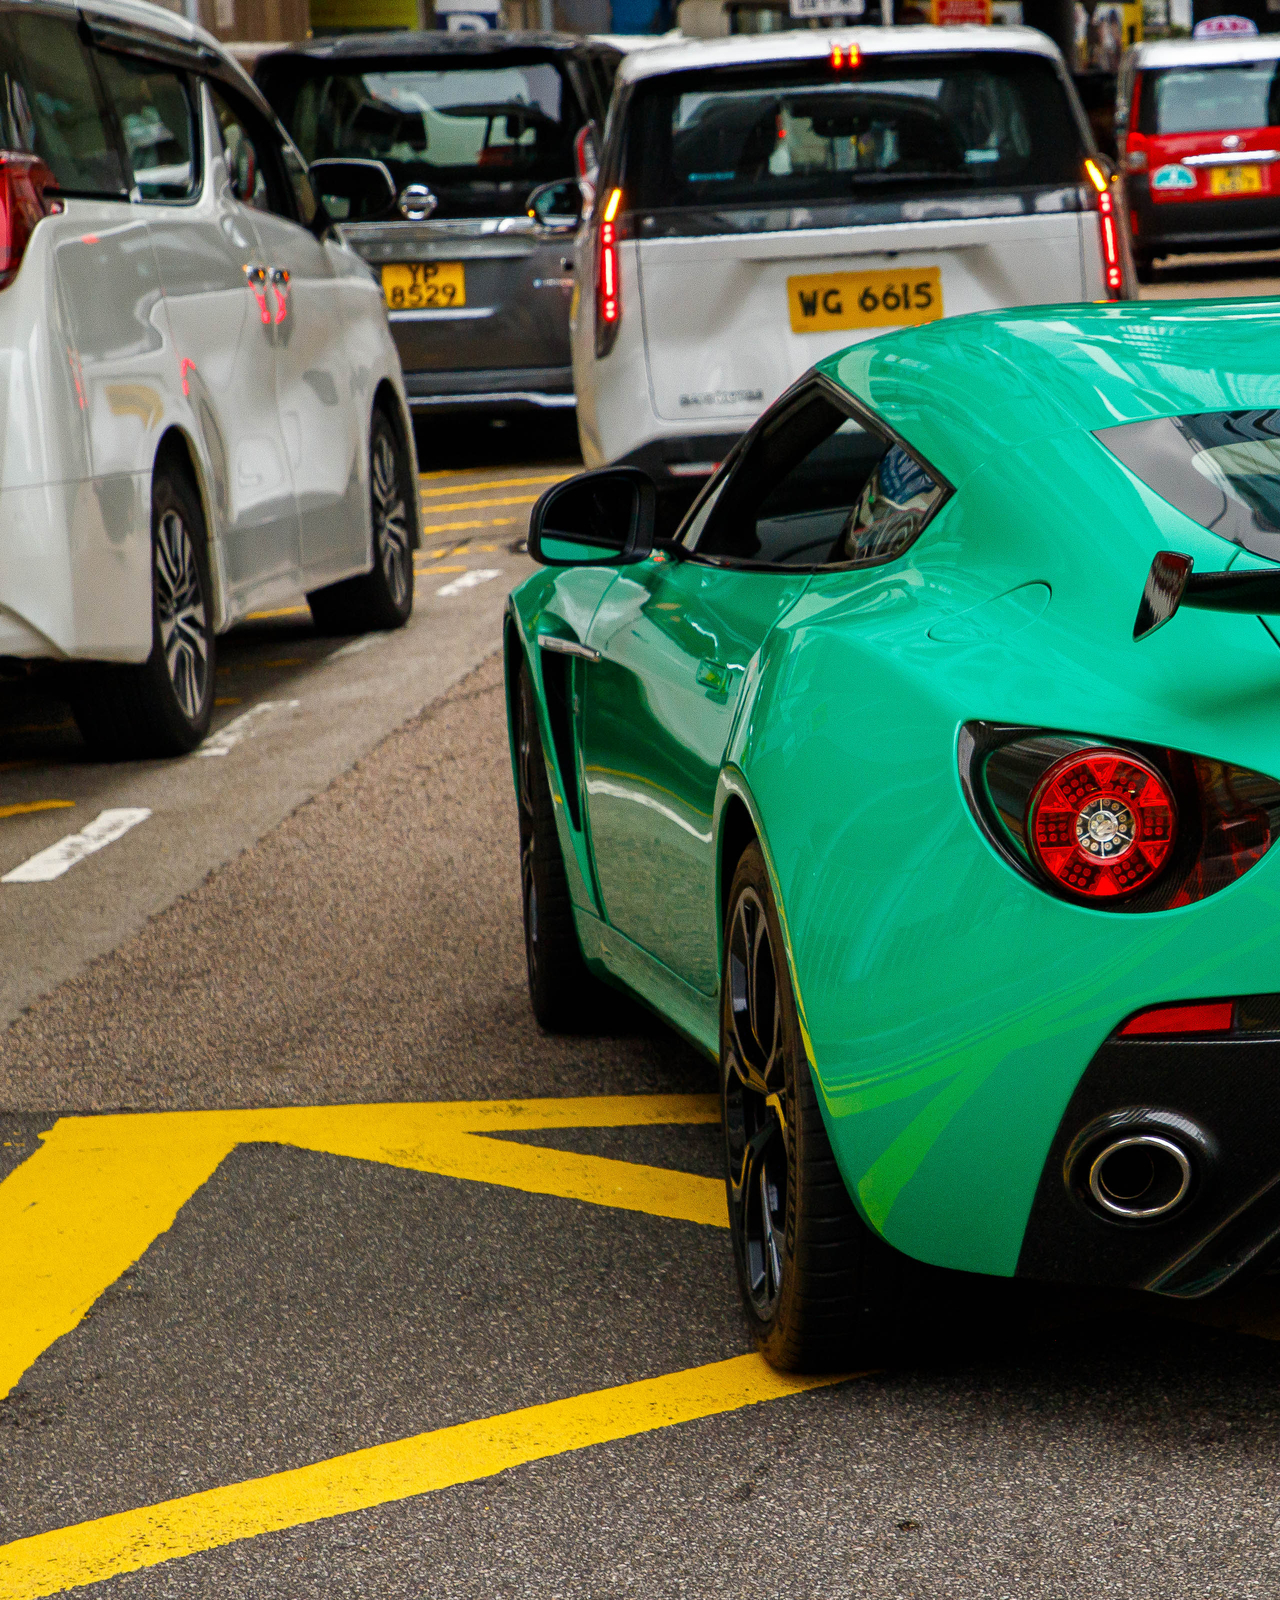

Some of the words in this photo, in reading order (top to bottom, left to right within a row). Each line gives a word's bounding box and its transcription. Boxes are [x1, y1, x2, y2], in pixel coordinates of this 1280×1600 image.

[408, 263, 440, 284] YP
[390, 283, 457, 307] 8529
[798, 288, 843, 317] WG
[858, 281, 934, 313] 6615
